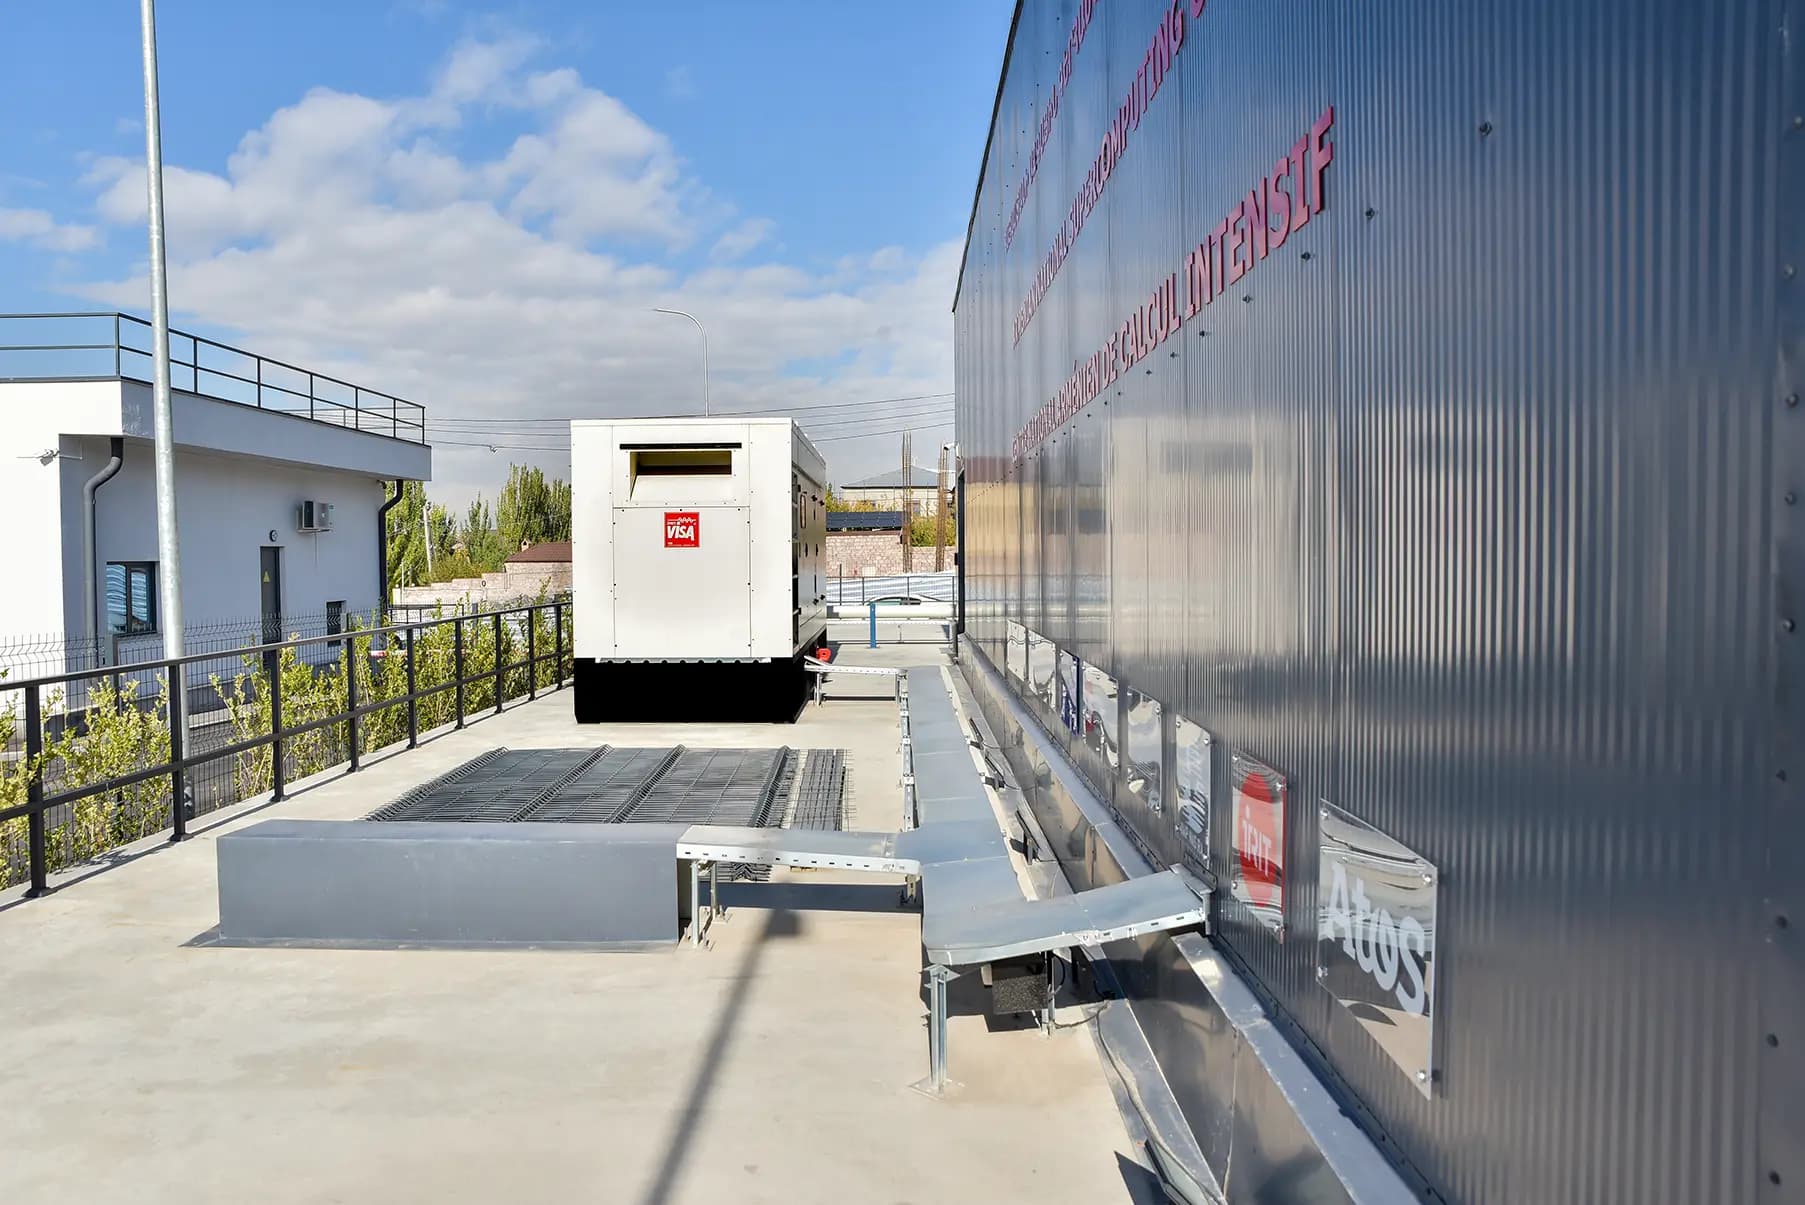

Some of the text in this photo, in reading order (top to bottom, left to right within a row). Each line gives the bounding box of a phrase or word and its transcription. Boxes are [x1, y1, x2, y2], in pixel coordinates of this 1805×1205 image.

[1070, 0, 1185, 247] SUPERCOMPUTING
[1102, 332, 1118, 390] DE
[1119, 273, 1182, 374] CALCUL
[1184, 106, 1335, 320] INTENSIF
